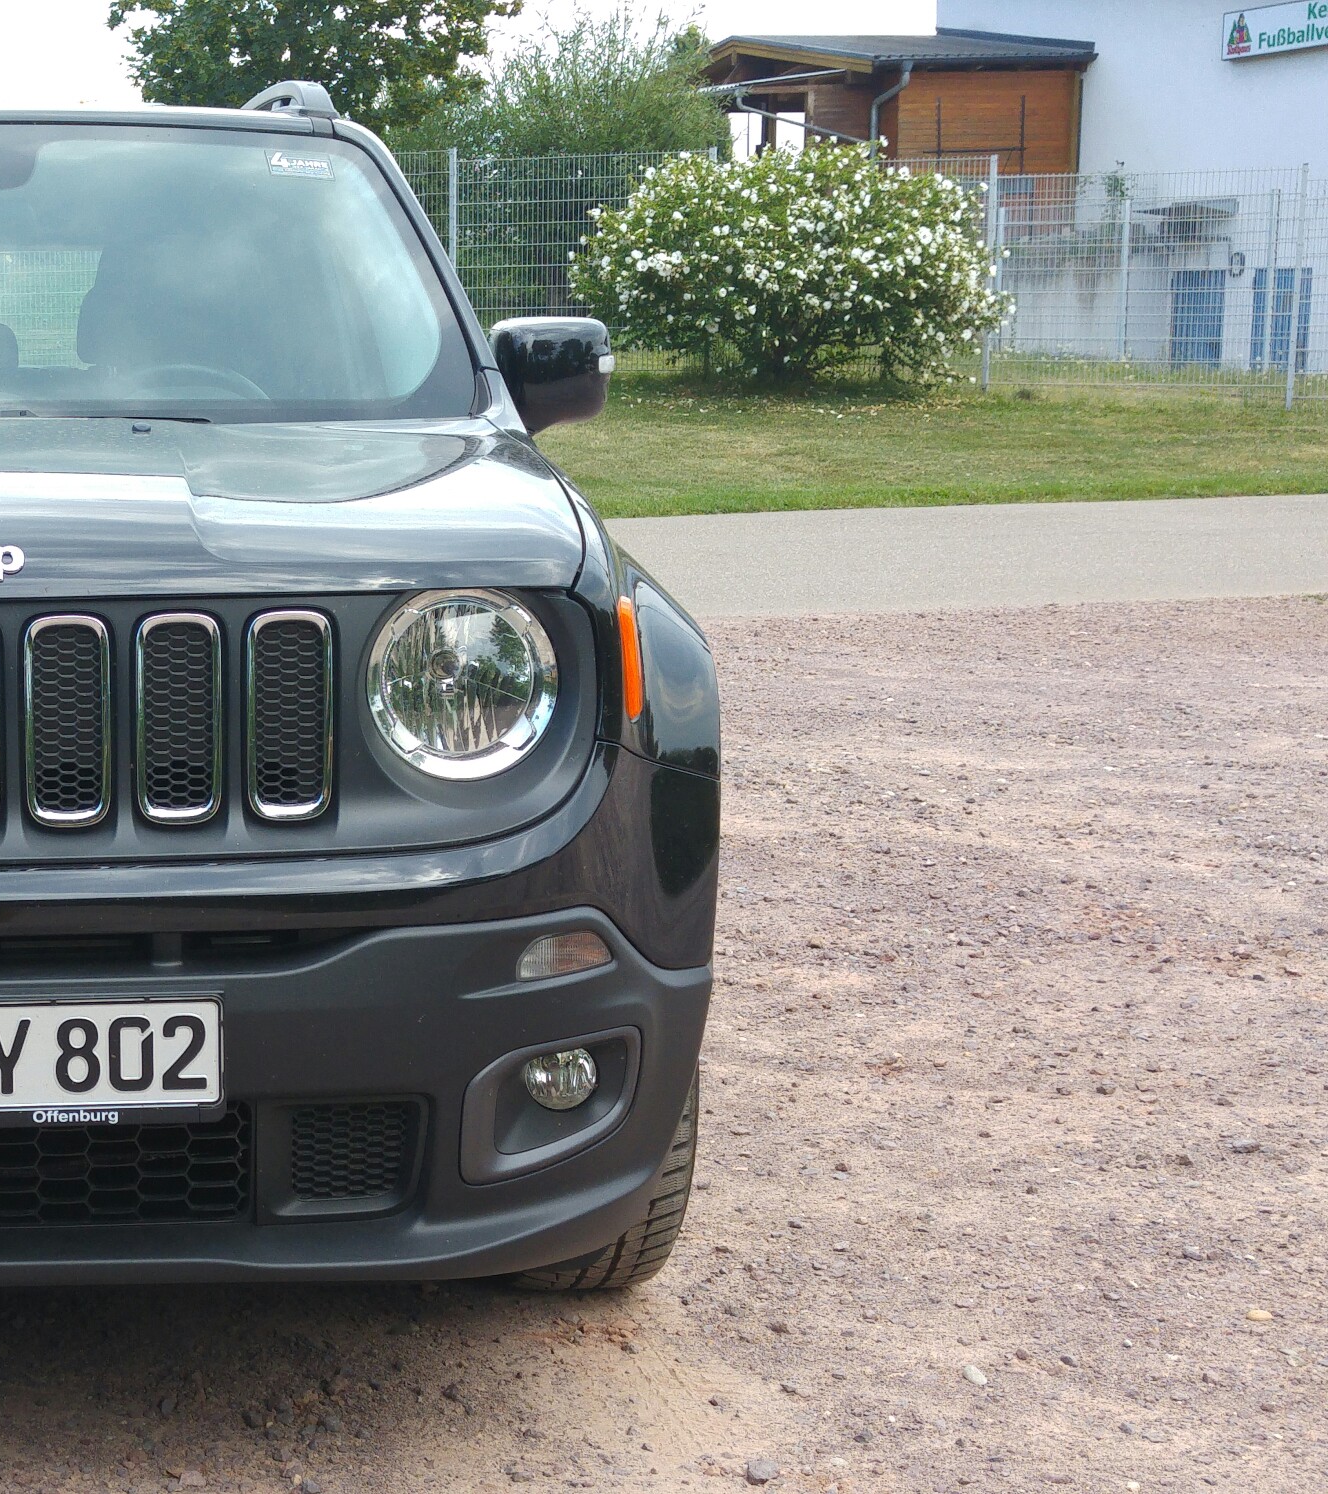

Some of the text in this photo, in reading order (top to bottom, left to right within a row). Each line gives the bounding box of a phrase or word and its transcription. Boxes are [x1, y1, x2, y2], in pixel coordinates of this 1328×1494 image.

[271, 152, 328, 169] 4 JAHRE
[54, 1015, 208, 1093] 802
[32, 1109, 119, 1125] Offenburg
